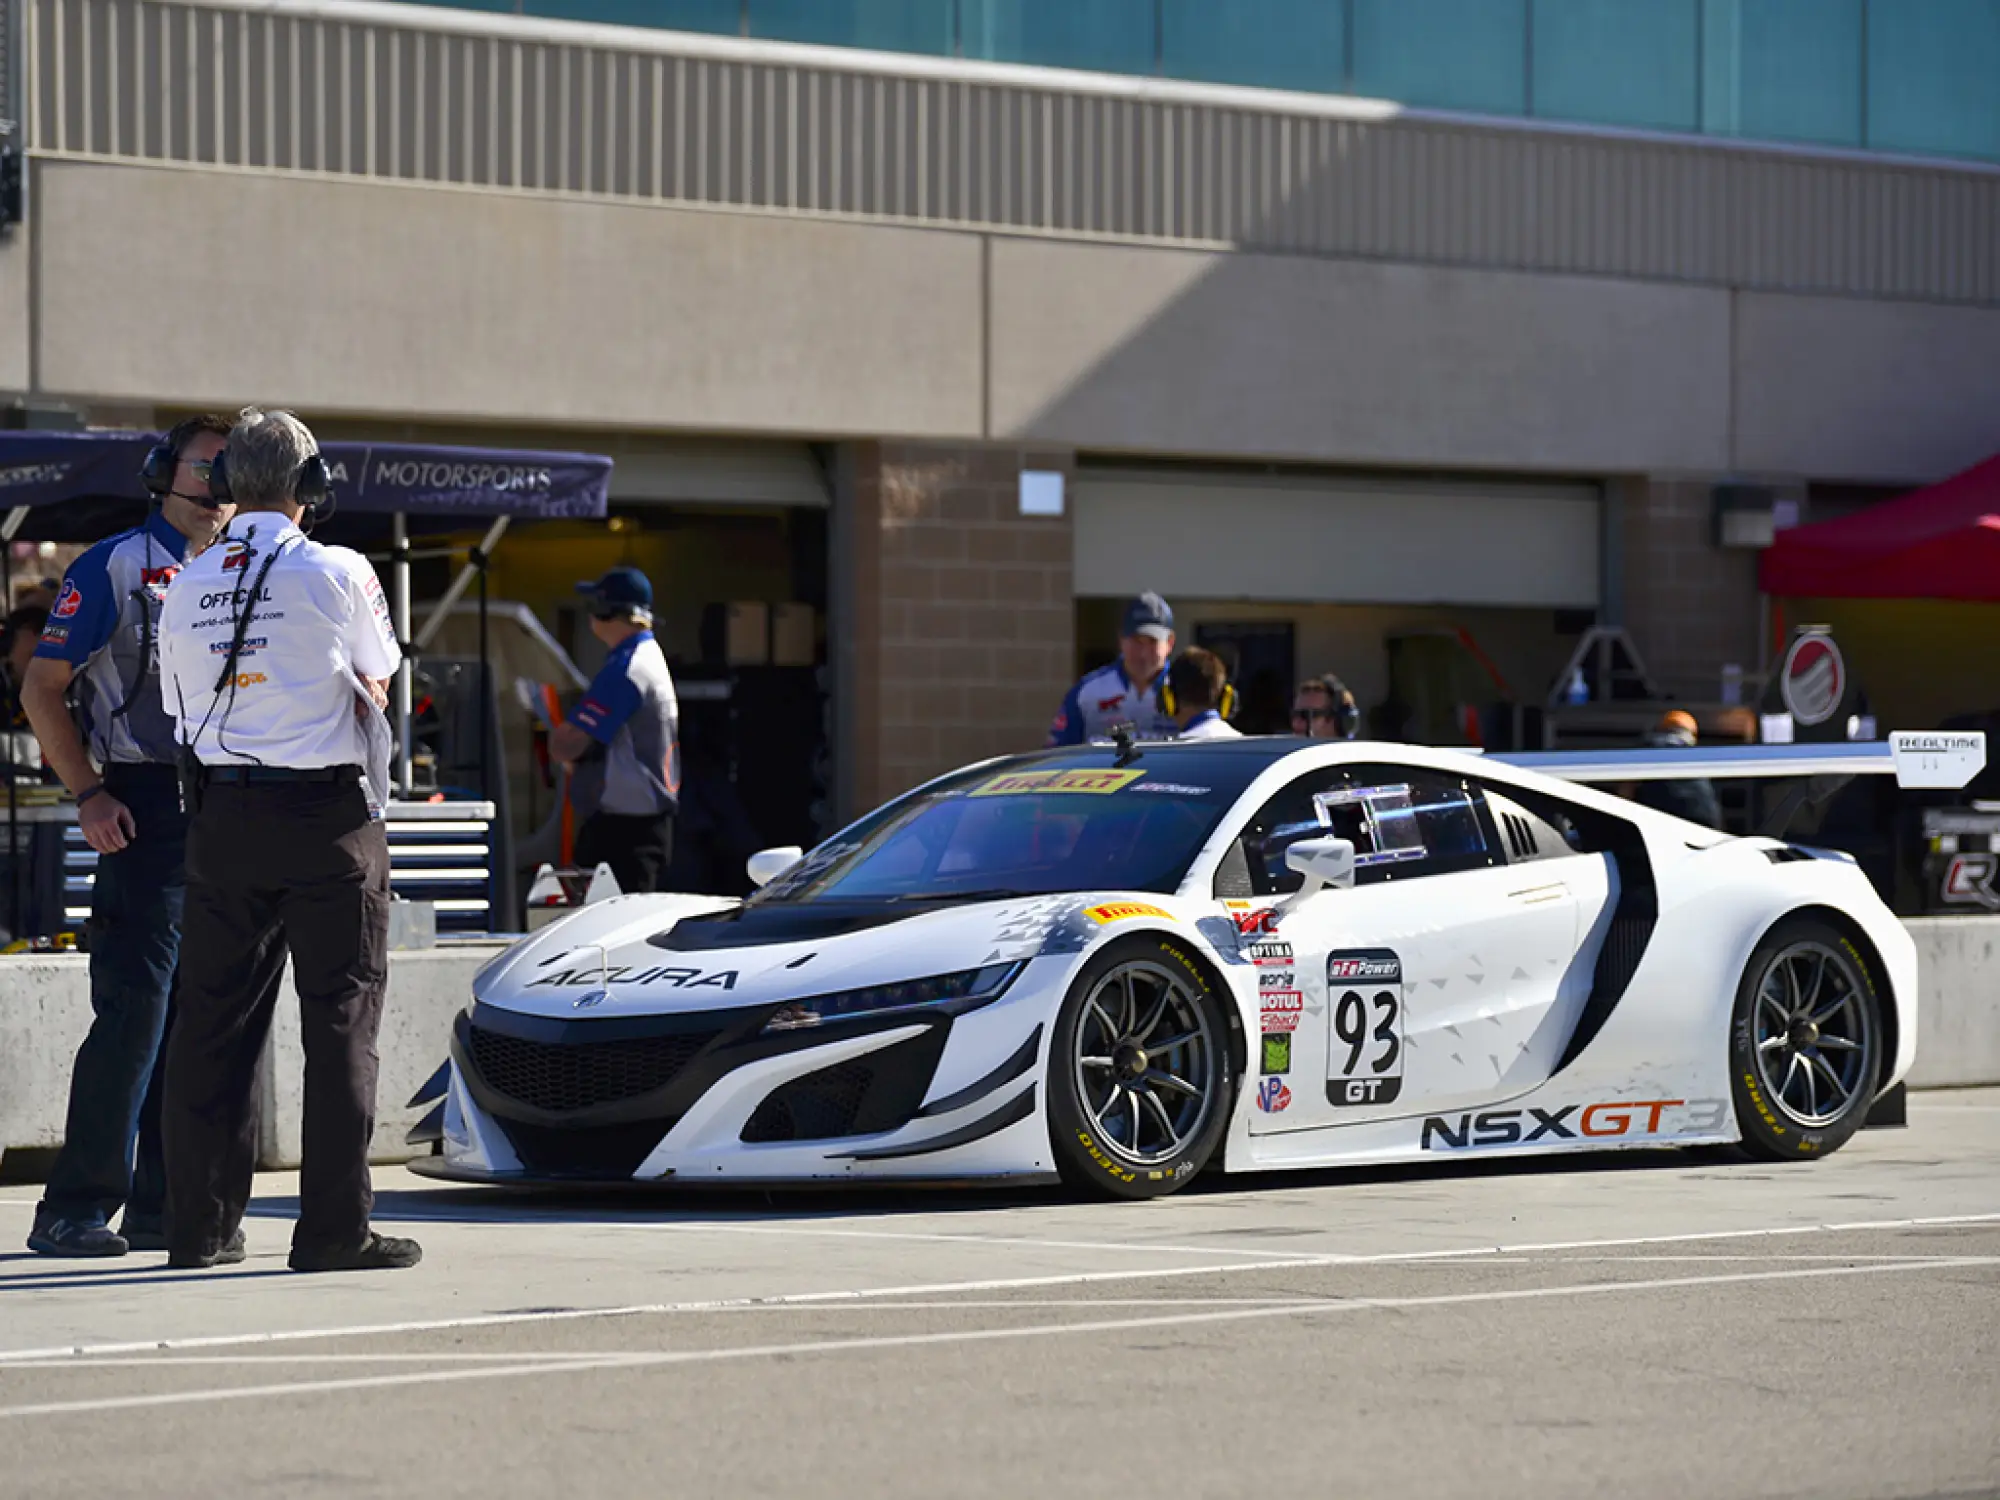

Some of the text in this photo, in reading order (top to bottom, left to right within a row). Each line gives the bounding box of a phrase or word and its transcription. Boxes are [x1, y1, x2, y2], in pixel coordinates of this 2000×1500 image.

[376, 462, 551, 491] MOTORSPORTS
[200, 588, 272, 610] OFFCAL
[523, 966, 740, 990] ACURA
[1335, 989, 1400, 1076] 93
[1346, 1080, 1382, 1102] GT
